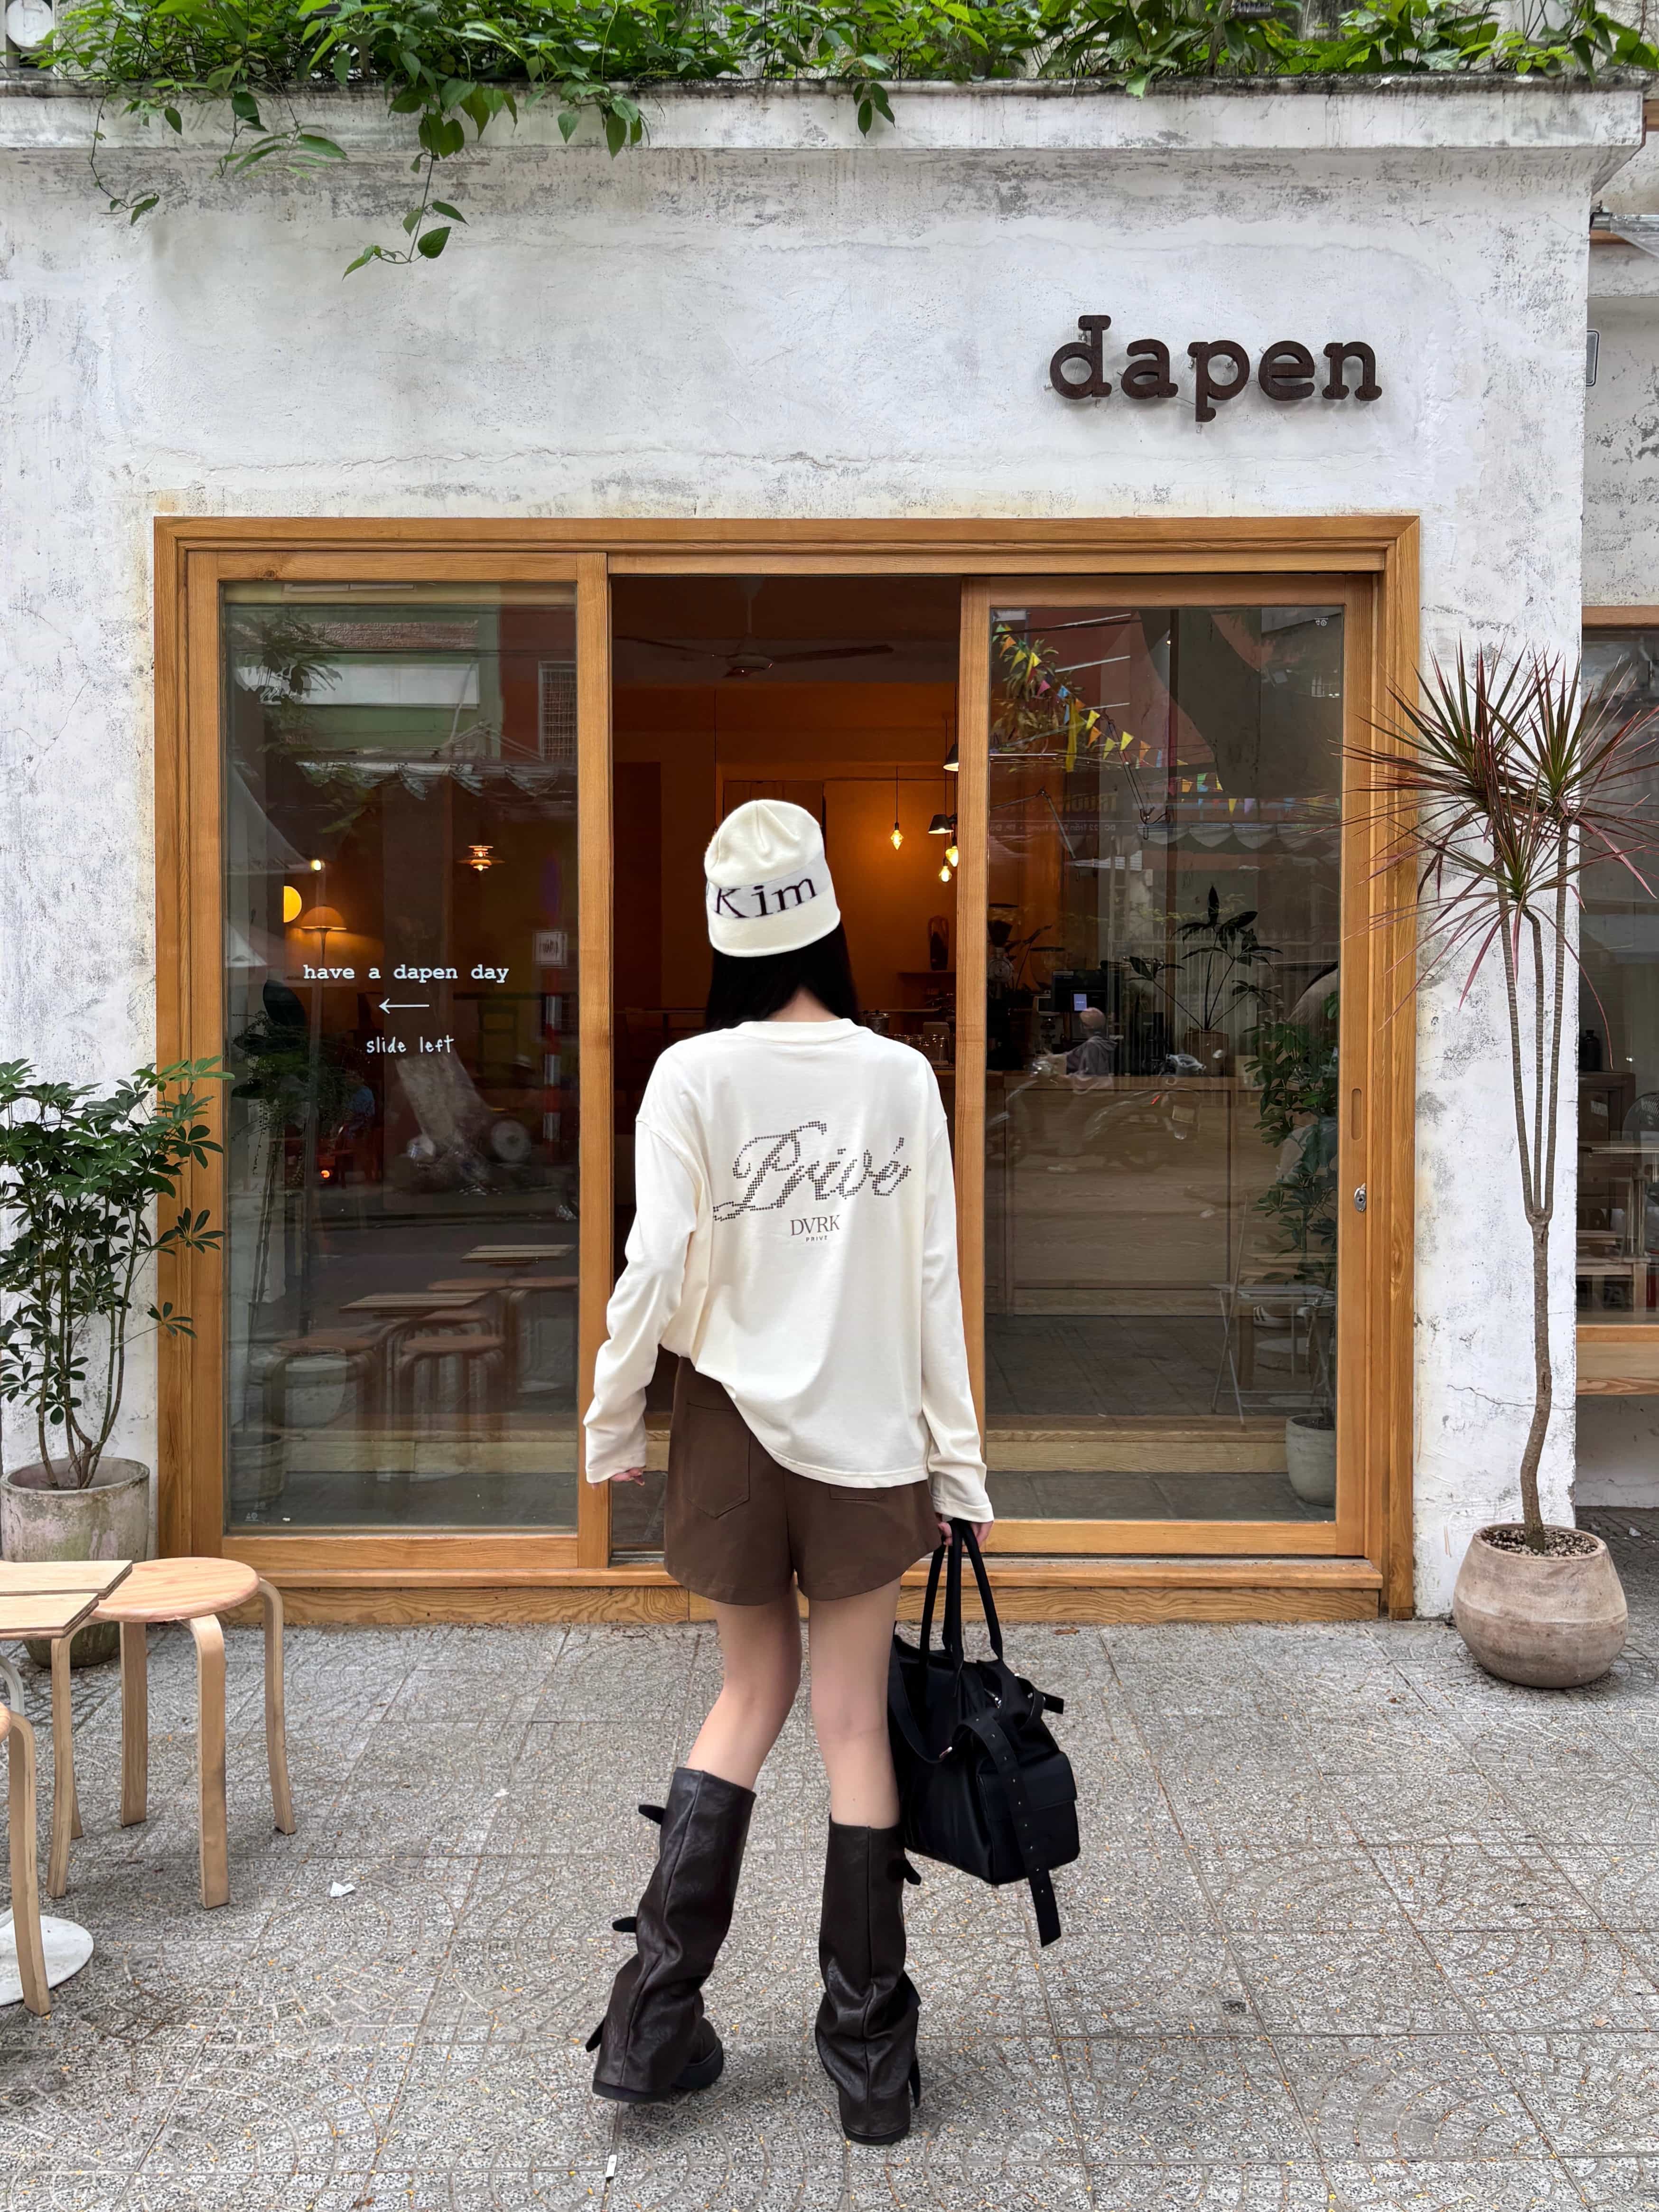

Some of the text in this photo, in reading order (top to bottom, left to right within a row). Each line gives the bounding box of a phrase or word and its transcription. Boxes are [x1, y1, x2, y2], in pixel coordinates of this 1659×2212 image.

[1050, 315, 1382, 422] dapen
[714, 878, 817, 918] Kim
[303, 964, 509, 984] have a dapen day
[366, 1034, 455, 1053] slide left
[790, 1214, 840, 1236] DVRK
